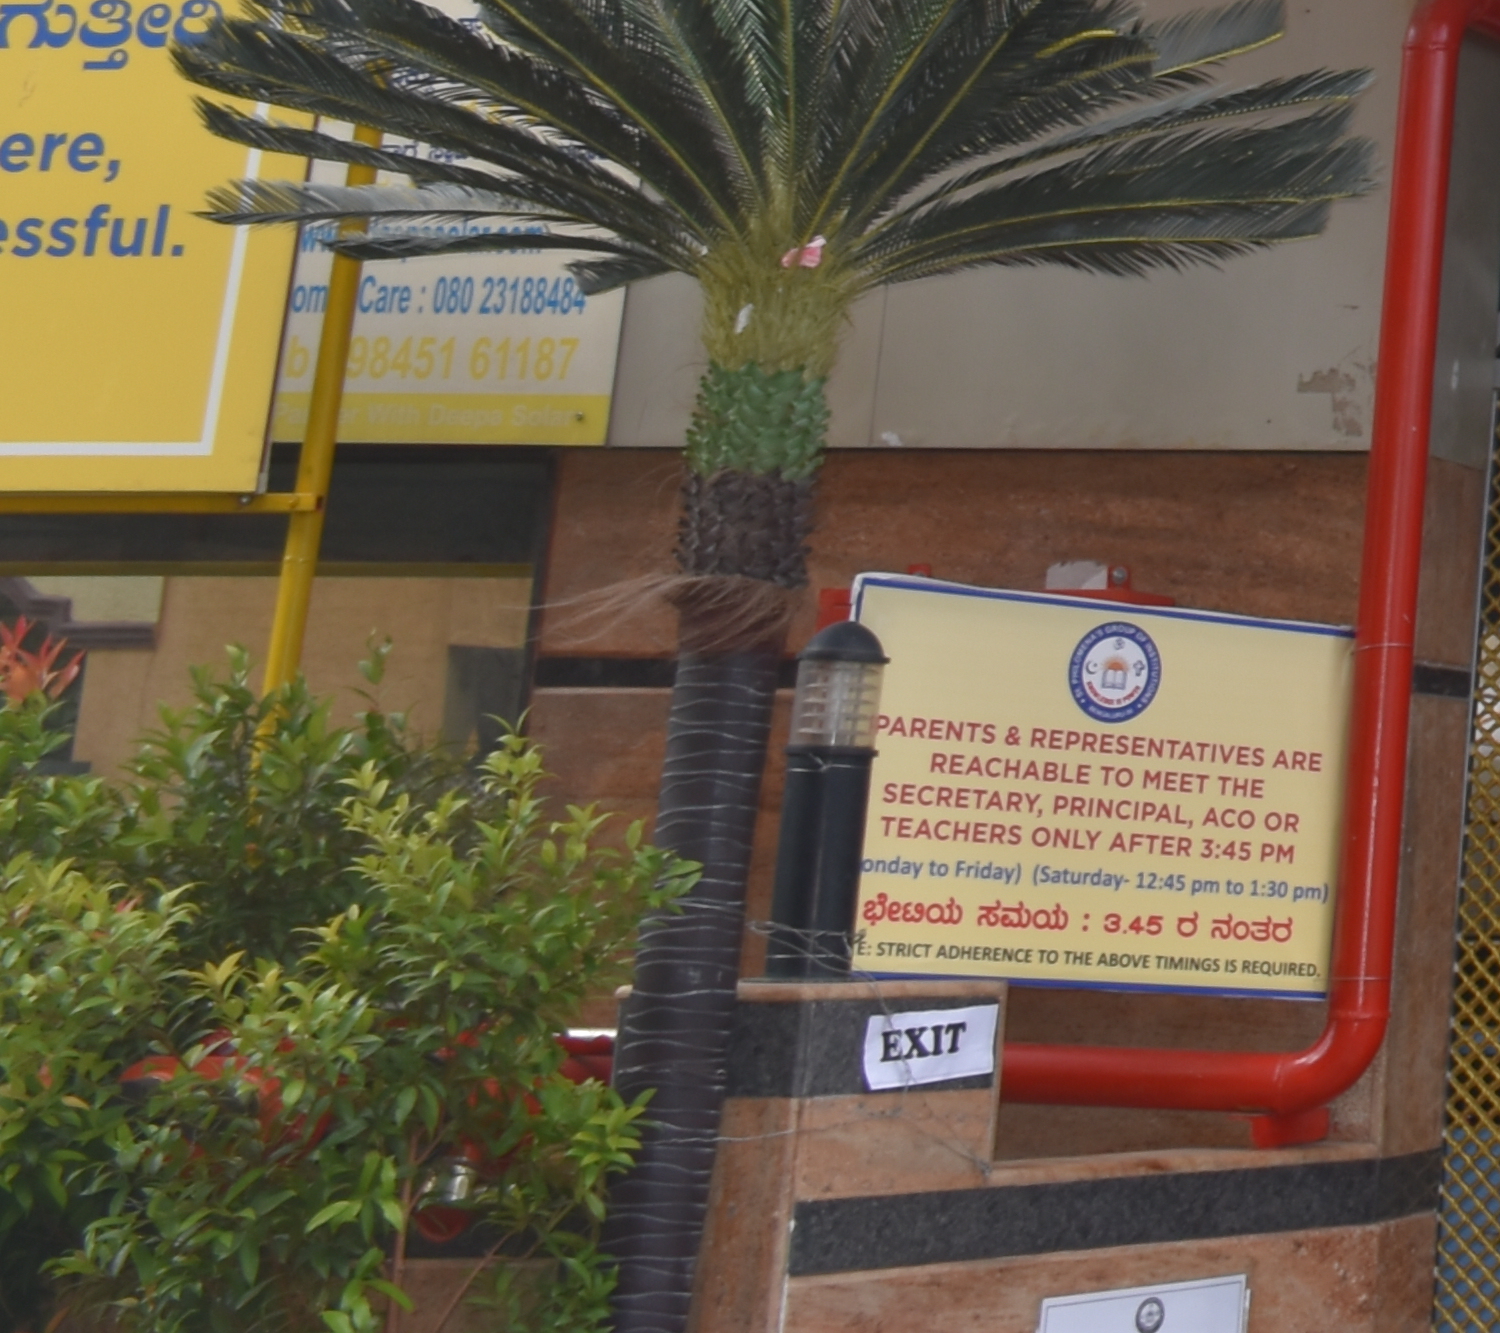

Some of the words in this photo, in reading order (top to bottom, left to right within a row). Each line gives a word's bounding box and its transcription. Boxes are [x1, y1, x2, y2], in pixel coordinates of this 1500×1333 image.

[358, 274, 412, 314] Care
[432, 275, 474, 314] 080
[467, 336, 581, 381] 61187
[872, 714, 996, 744] PARENTS
[1004, 725, 1021, 746] &
[1030, 727, 1265, 767] REPRESENTATIVES
[1272, 749, 1323, 772] ARE
[930, 752, 1091, 785] REACHABLE
[1100, 765, 1134, 787] TO
[1142, 769, 1209, 793] MEET
[1218, 775, 1265, 799] THE
[882, 782, 1044, 818] SECRETARY,
[1053, 795, 1194, 829] PRINCIPAL,
[1202, 807, 1256, 830] ACO
[1264, 811, 1300, 833] OR
[881, 816, 1022, 845] TEACHERS
[1031, 826, 1102, 851] ONLY
[1109, 831, 1193, 857] AFTER
[1200, 838, 1252, 861] 3:45
[1260, 842, 1296, 864] PM
[860, 855, 924, 879] onday
[928, 859, 949, 878] to
[955, 859, 1022, 885] Friday)
[1135, 870, 1187, 892] 12:45
[1190, 877, 1220, 896] pm
[1225, 878, 1245, 897] to
[1249, 878, 1289, 899] 1:30
[1292, 882, 1330, 905] pm)
[977, 897, 1070, 932] ಸಮಯ
[1210, 911, 1294, 943] ನಂತರ
[876, 941, 934, 959] STRICT
[936, 943, 1032, 963] ADHERENCE
[1037, 948, 1059, 965] TO
[1063, 949, 1093, 967] THE
[1096, 951, 1151, 970] ABOVE
[1154, 954, 1221, 973] TIMINGS
[1224, 958, 1238, 974] IS
[1241, 959, 1322, 978] REQUIRED.
[878, 1021, 968, 1063] EXIT
